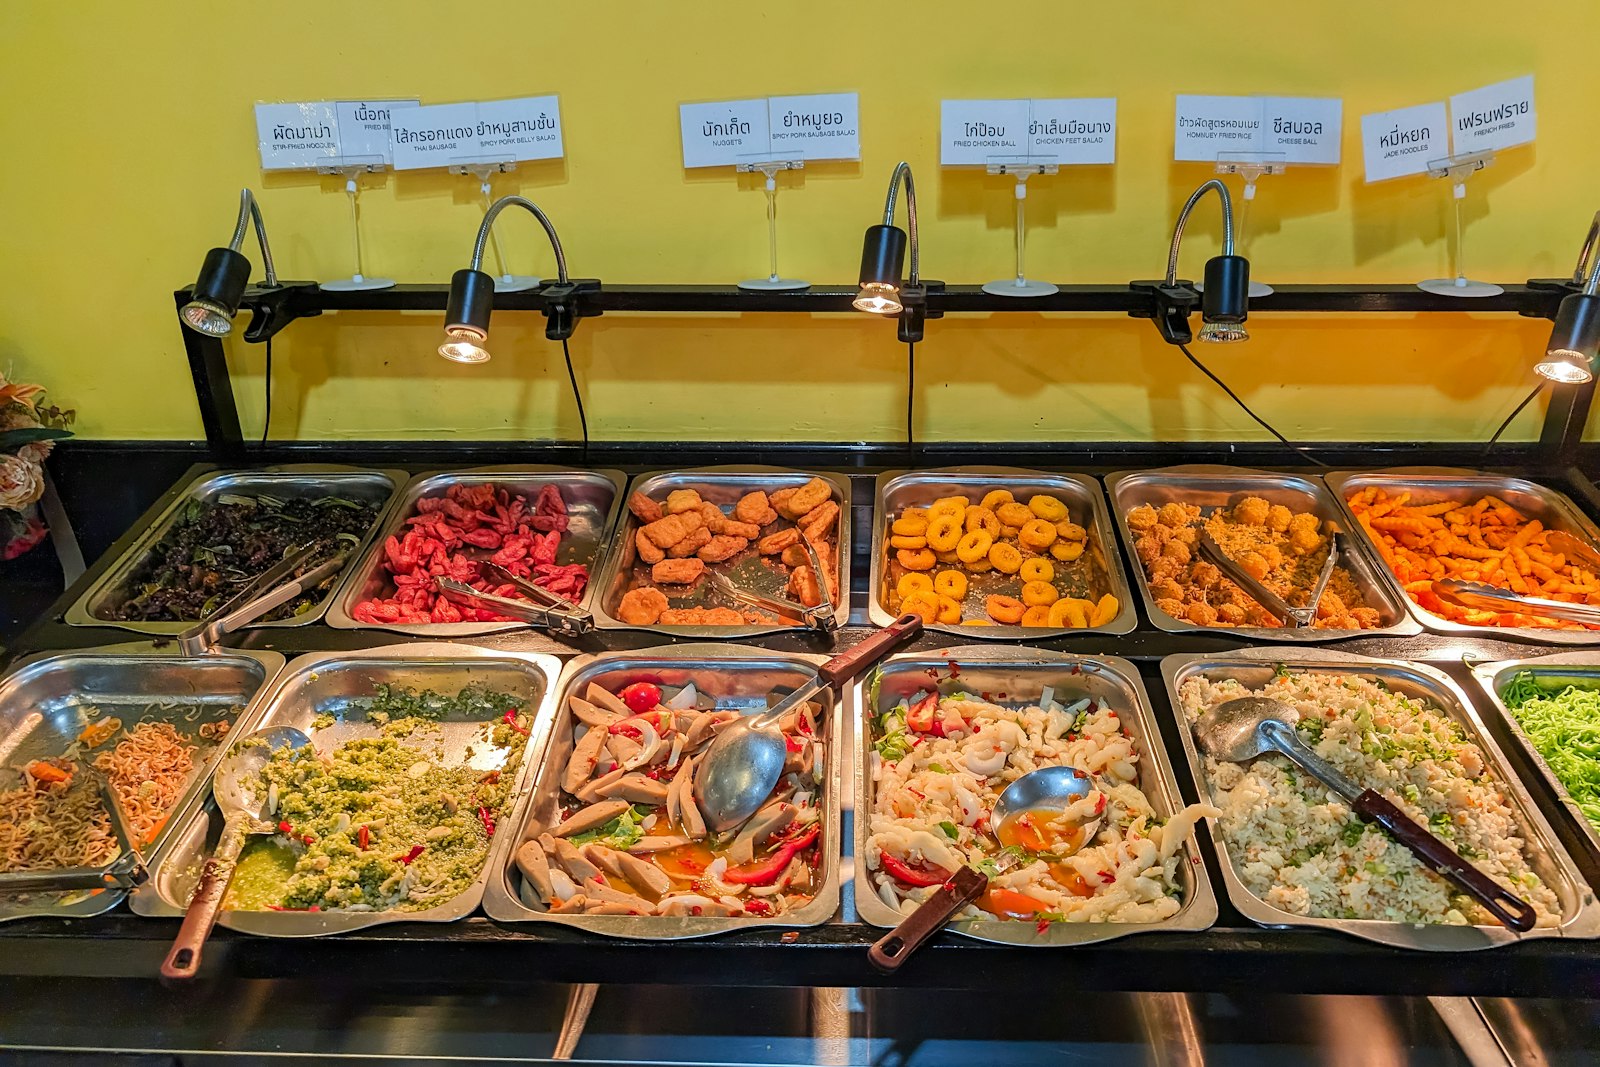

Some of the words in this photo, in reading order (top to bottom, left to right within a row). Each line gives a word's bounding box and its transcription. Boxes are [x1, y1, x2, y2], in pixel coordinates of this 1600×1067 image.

[783, 111, 843, 130] ยำหมูยอ
[1458, 100, 1530, 131] เฟรนฟราย
[273, 122, 331, 140] ผัดมาม่า
[476, 113, 555, 137] ยำหมูสามชั้น
[702, 117, 751, 137] นักเก็ต
[836, 129, 856, 137] SALAD
[1028, 119, 1112, 136] ยำเล็บมือนาง
[1273, 117, 1323, 135] ชีสบอล
[1473, 127, 1499, 137] FRENCH
[1498, 121, 1516, 131] FRIES
[394, 127, 473, 144] ไส้กรอกแดง
[480, 140, 498, 148] SPICY
[535, 134, 556, 142] SALAD
[712, 138, 743, 147] NUGGETS
[1186, 131, 1217, 139] HOMNUEY
[1237, 132, 1252, 140] RICE
[1277, 137, 1302, 145] CHEESE
[1379, 124, 1431, 149] หมี่หยก
[428, 143, 457, 151] SAUSAGE
[1383, 150, 1400, 159] JADE
[1400, 144, 1429, 155] NOODLES
